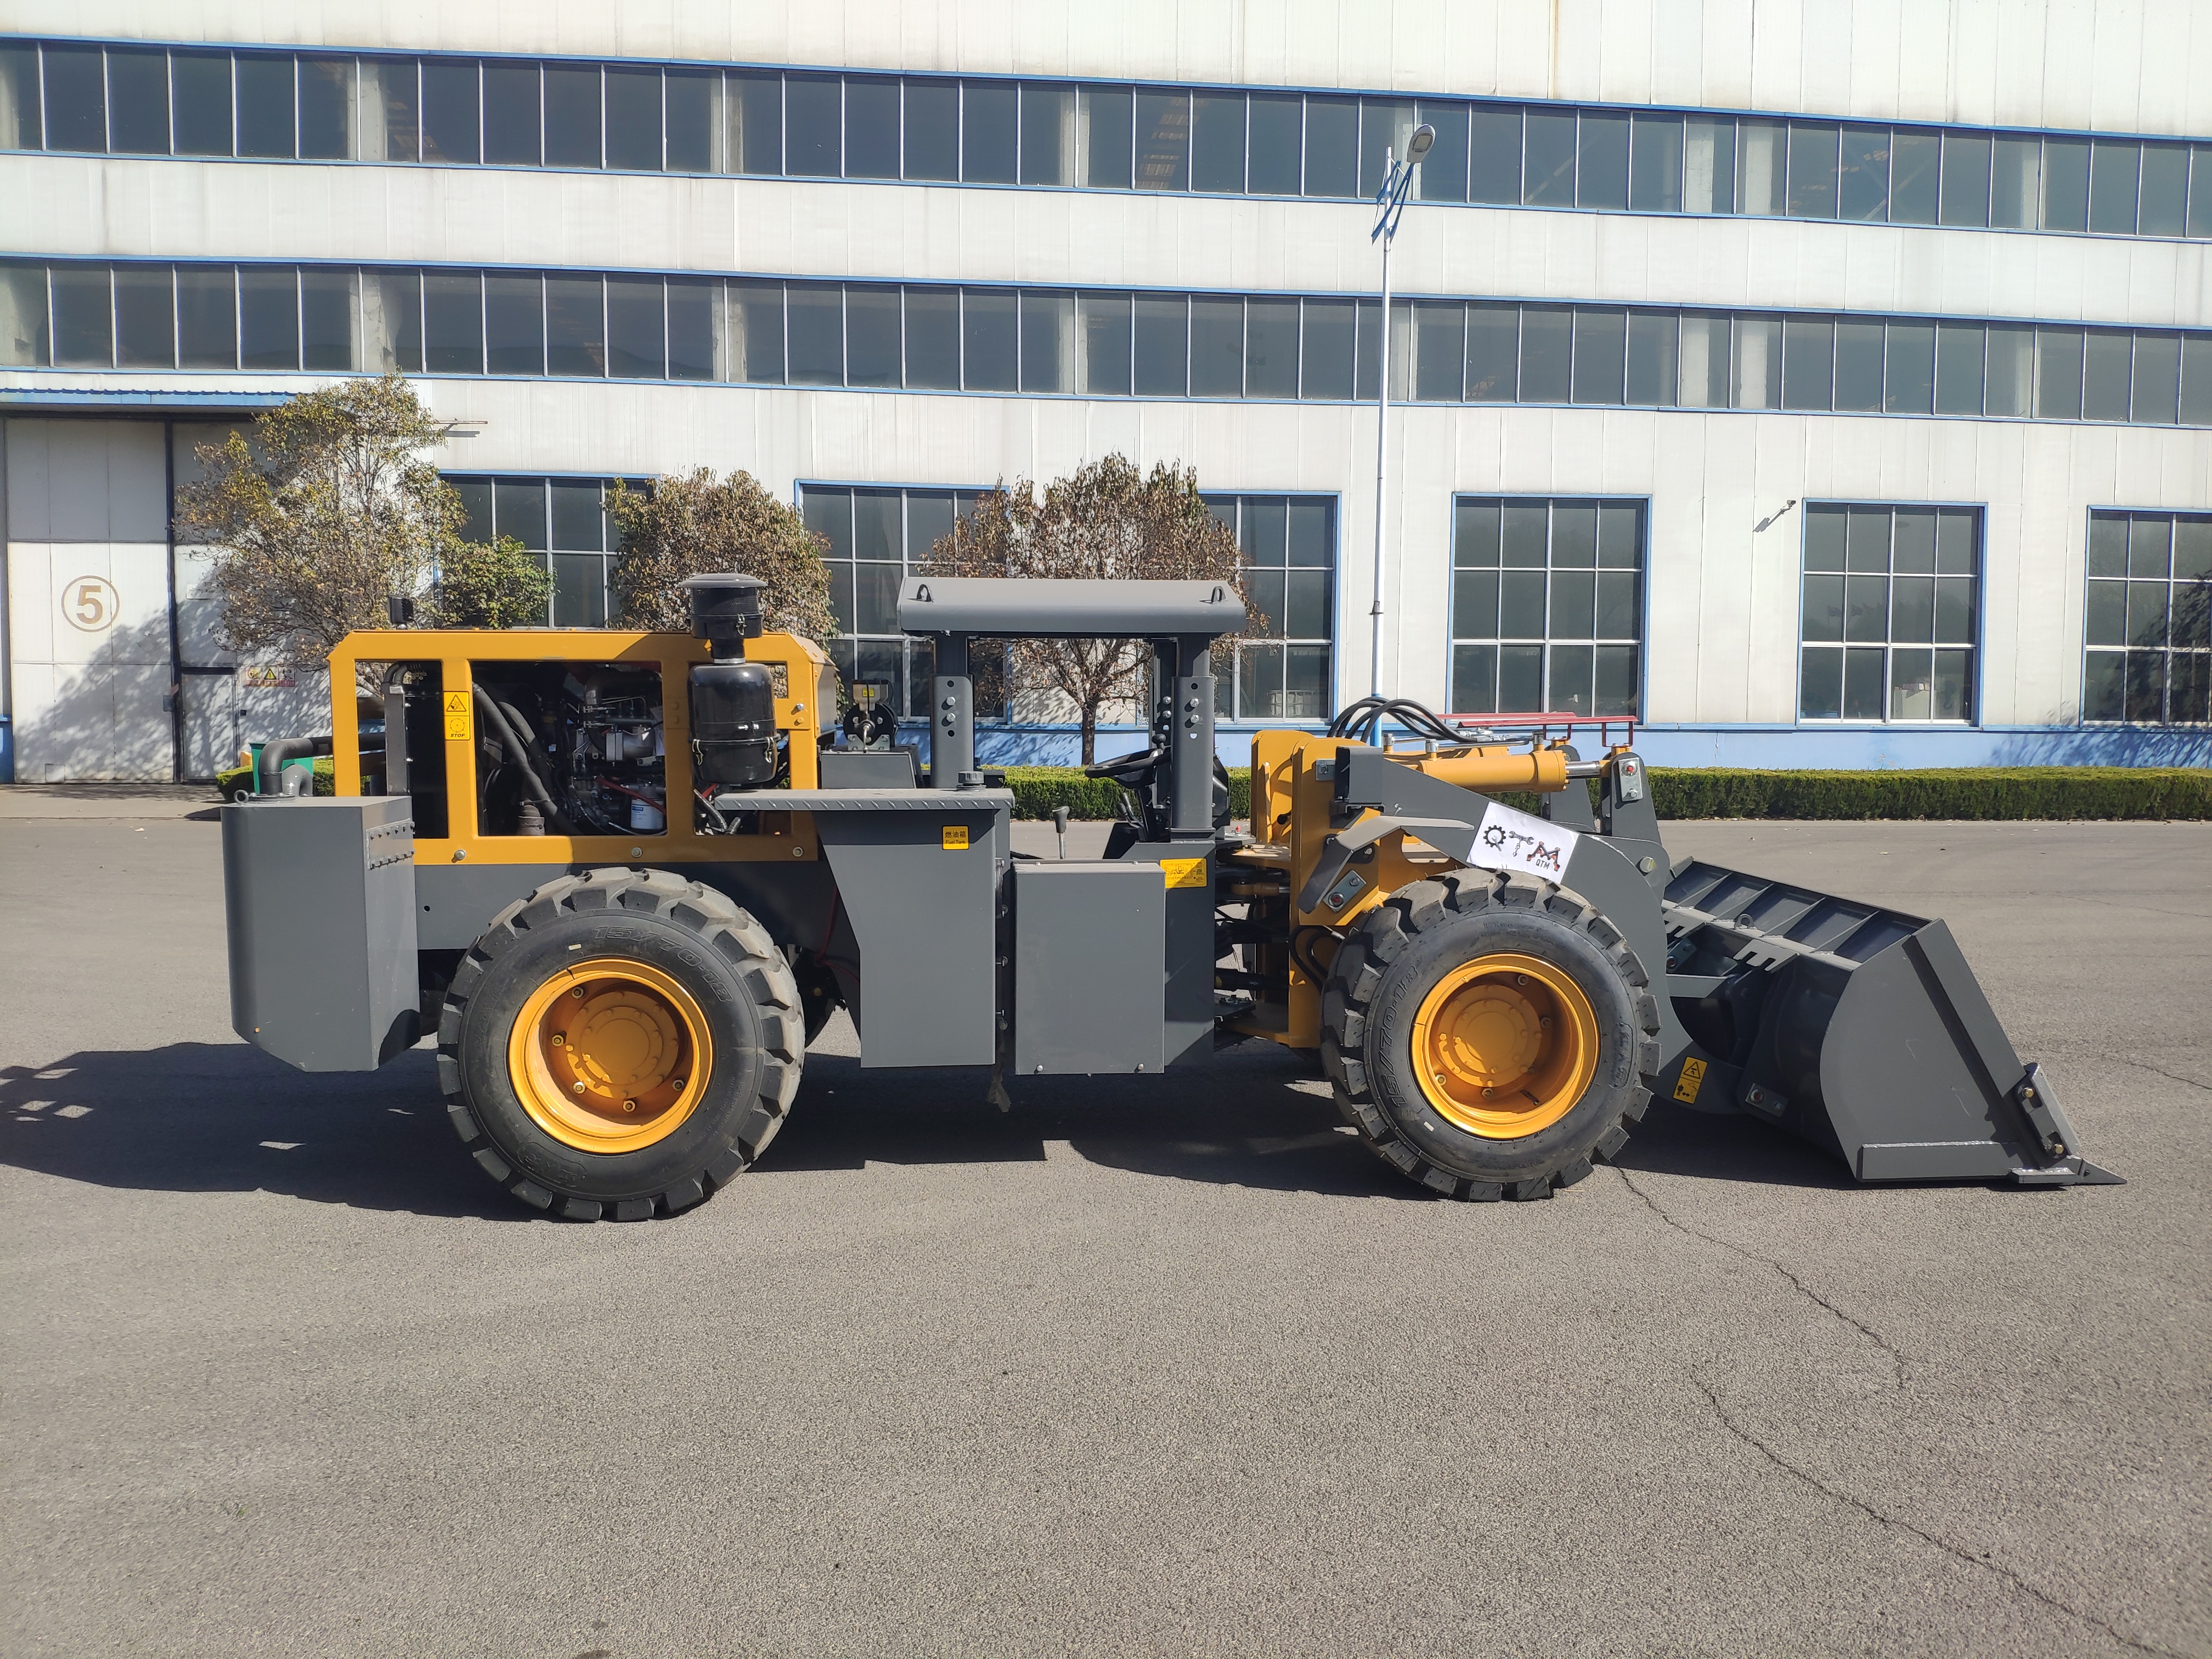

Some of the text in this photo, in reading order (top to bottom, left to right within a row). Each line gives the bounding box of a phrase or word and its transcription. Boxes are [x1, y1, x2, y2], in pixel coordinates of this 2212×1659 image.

[76, 585, 104, 624] 5
[1535, 859, 1550, 870] QTM
[594, 926, 733, 1002] 15/70-18
[1379, 964, 1419, 1107] 15/70-18
